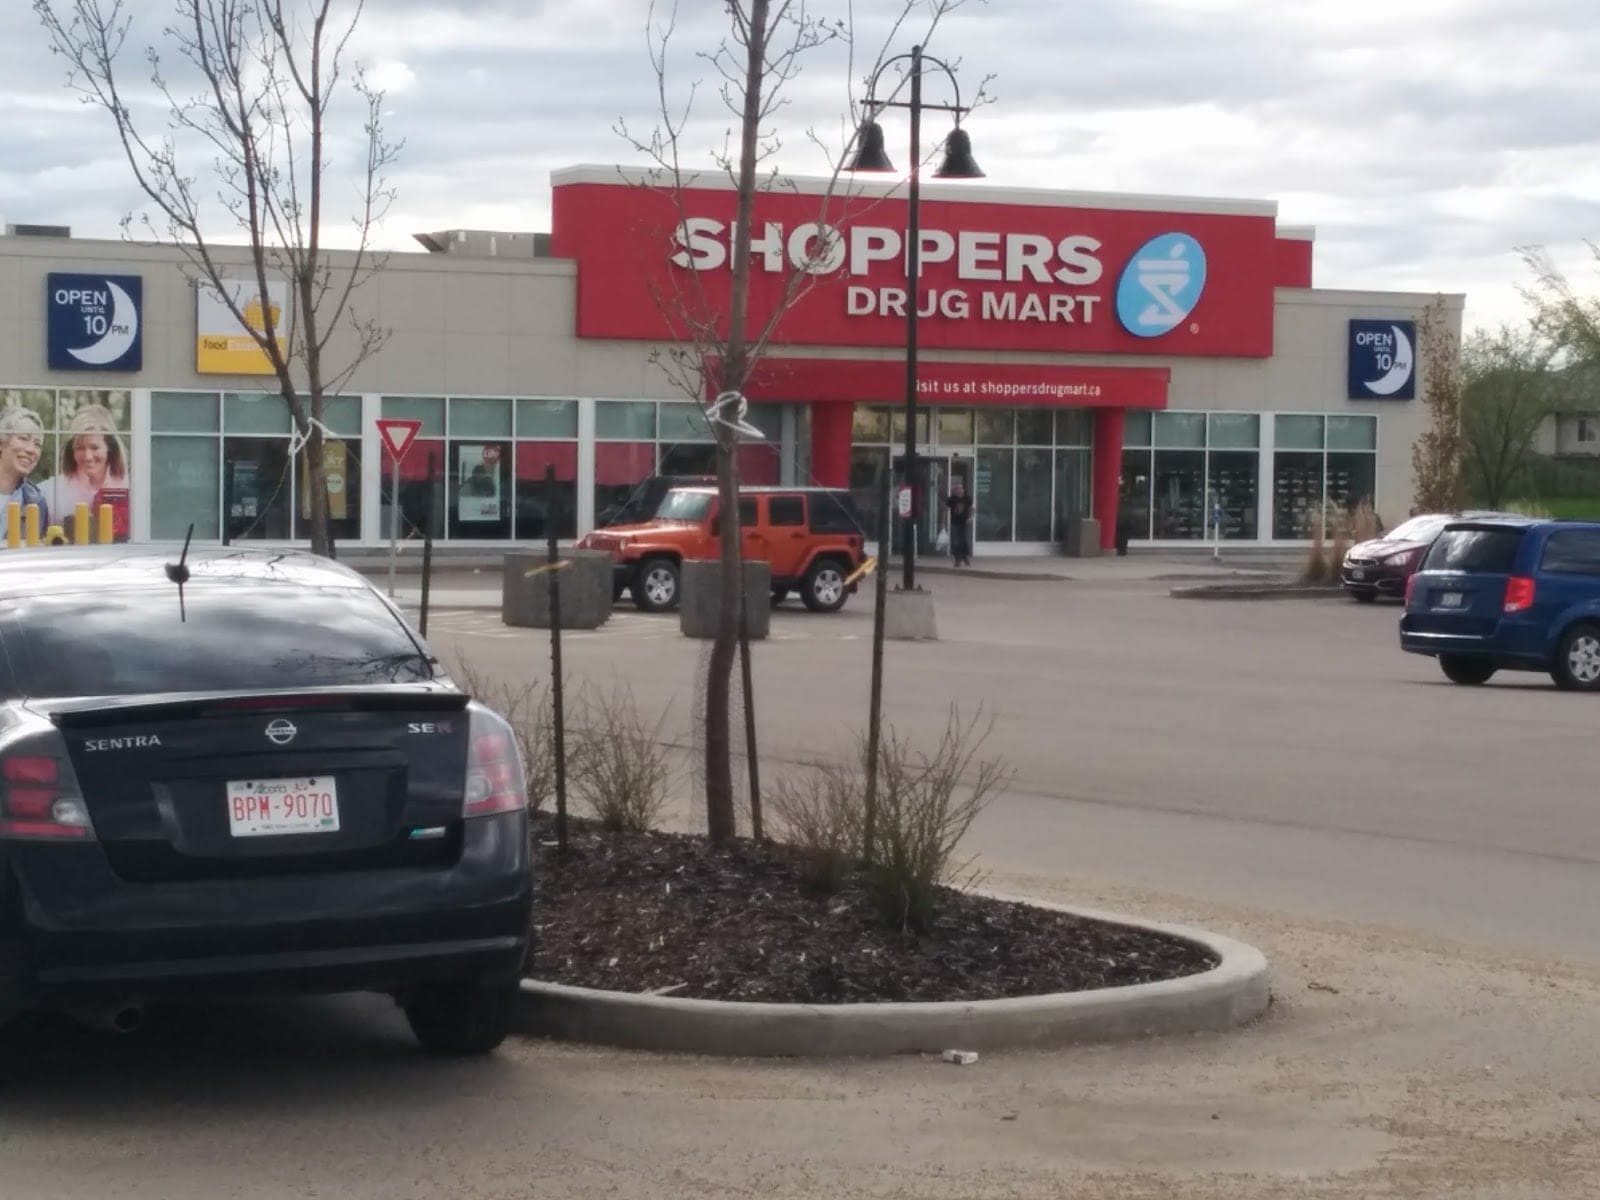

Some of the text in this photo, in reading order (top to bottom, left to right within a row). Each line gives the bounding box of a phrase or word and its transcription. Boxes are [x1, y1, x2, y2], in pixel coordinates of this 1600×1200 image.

[670, 216, 1103, 286] SHOPPERS
[55, 289, 107, 305] OPEN
[847, 285, 1101, 324] DRUG MART
[83, 315, 129, 336] 10 PM
[1356, 332, 1392, 346] OPEN
[1375, 353, 1391, 370] 10
[914, 379, 1101, 398] isit us at shoppersdrugmart.ca
[85, 734, 162, 752] SENTRA
